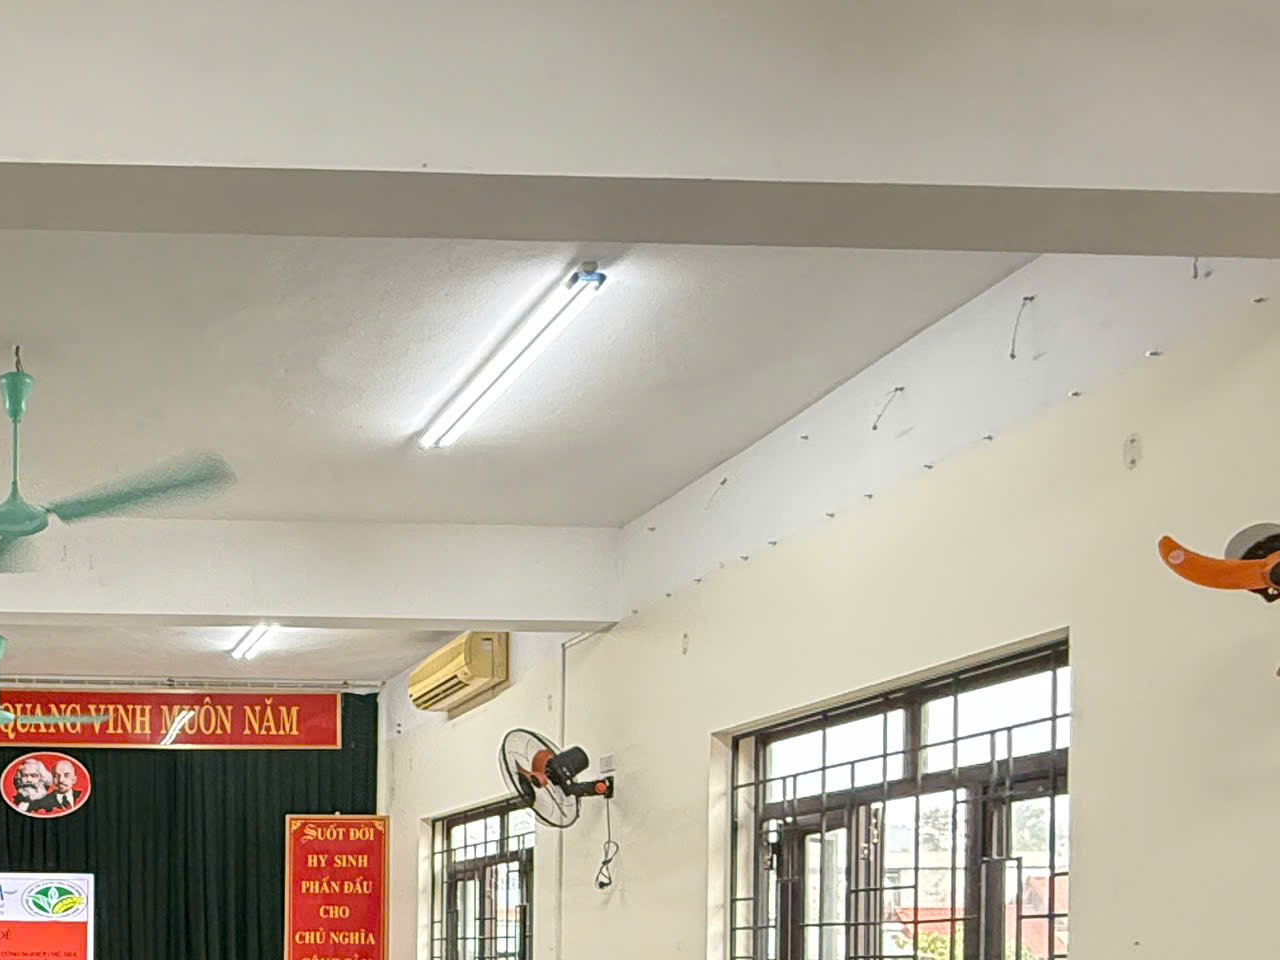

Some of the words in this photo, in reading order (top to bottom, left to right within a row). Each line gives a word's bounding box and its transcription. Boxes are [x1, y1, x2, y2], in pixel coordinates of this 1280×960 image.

[88, 703, 152, 734] VINH
[243, 697, 300, 736] NĂM
[300, 823, 346, 844] SUỐT
[307, 854, 328, 868] HY
[334, 854, 368, 868] SINH
[301, 874, 340, 894] PHẤN
[343, 876, 374, 894] ĐẤU
[320, 905, 350, 919] CHO
[295, 927, 326, 944] CHỦ
[329, 928, 376, 944] NGHĨA
